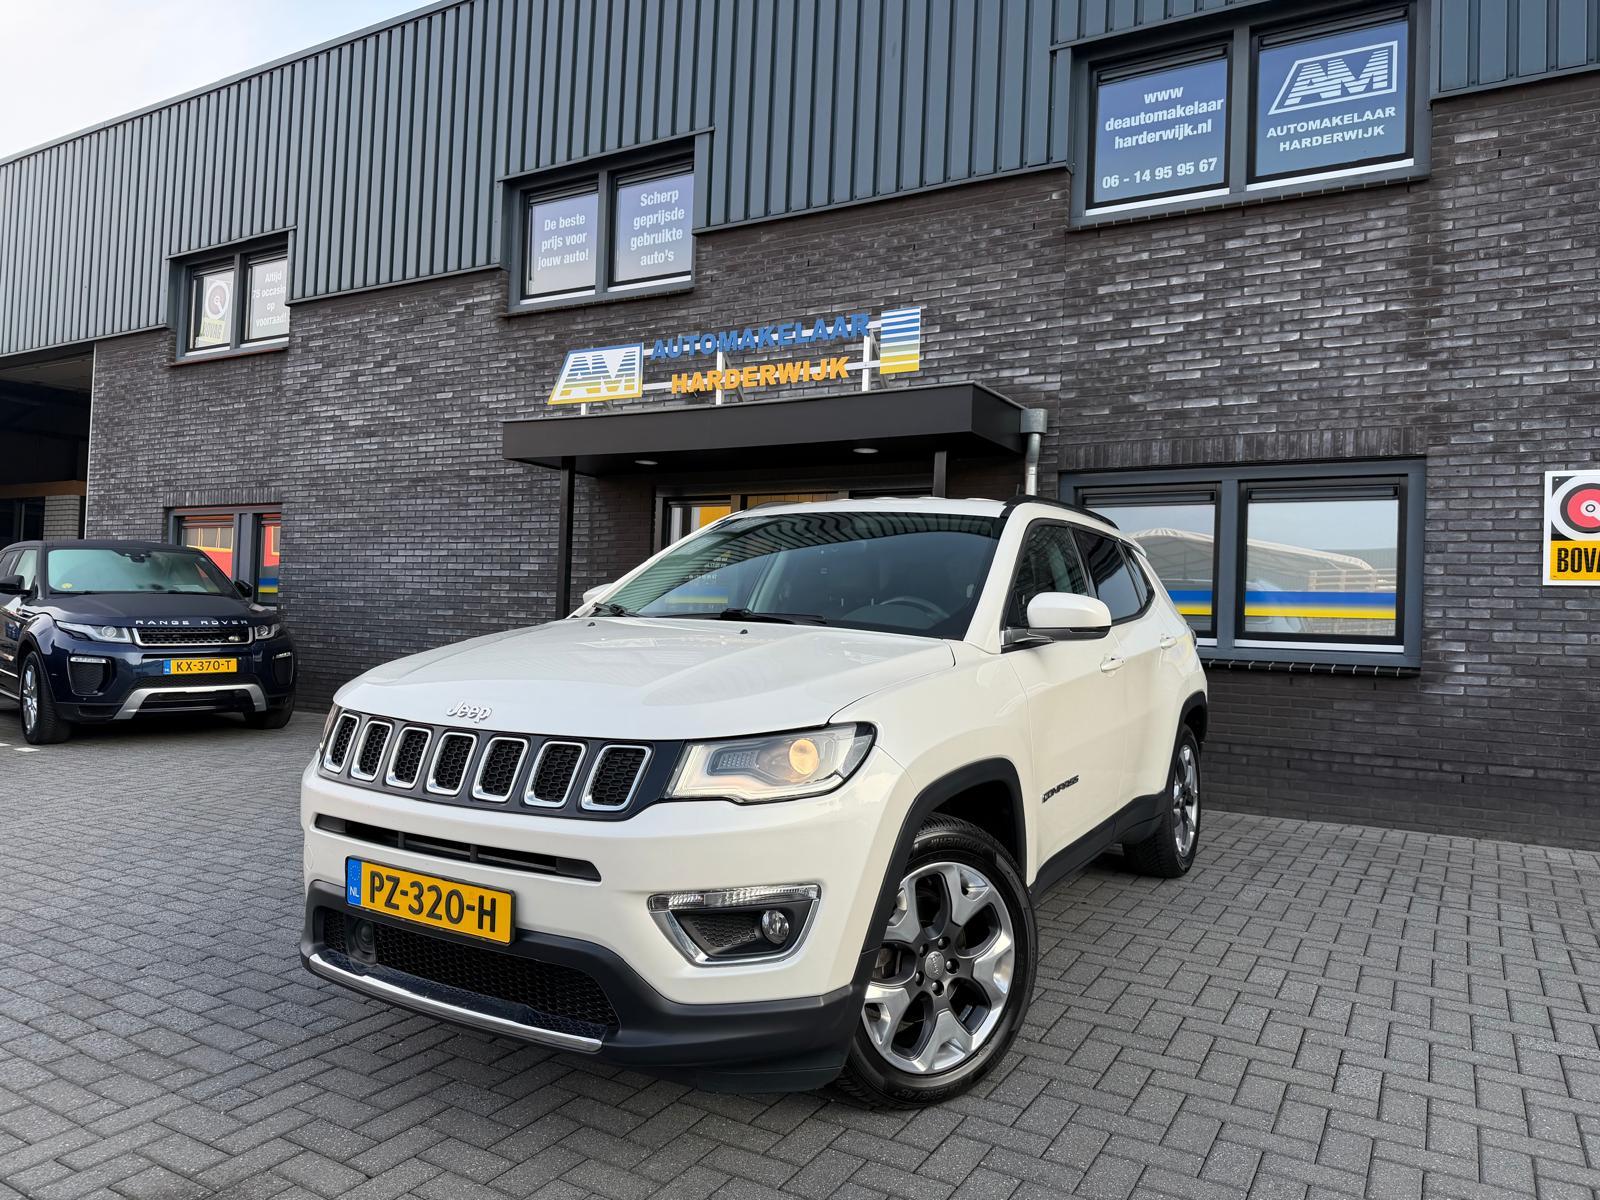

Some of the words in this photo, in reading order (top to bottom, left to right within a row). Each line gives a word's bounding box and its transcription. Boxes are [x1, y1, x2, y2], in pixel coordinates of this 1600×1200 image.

[1143, 85, 1183, 104] www
[1105, 98, 1224, 132] deautomakelaar
[1266, 106, 1397, 138] AUTOMAKELAAR
[1114, 119, 1212, 150] harderwijk.nl
[1279, 124, 1385, 152] HARDERWIJK
[1102, 173, 1119, 189] 06
[1134, 168, 1151, 184] 14
[1154, 165, 1173, 181] 95
[1176, 161, 1195, 177] 95
[1198, 157, 1218, 173] 67
[640, 189, 679, 207] Scherp
[544, 219, 557, 231] De
[559, 213, 586, 229] beste
[633, 207, 685, 230] geprijsde
[541, 235, 563, 252] prijs
[566, 231, 587, 247] voor
[630, 228, 683, 251] gebruikte
[537, 254, 561, 271] jouw
[564, 248, 589, 263] auto!
[640, 250, 675, 266] auto's
[266, 302, 275, 311] op
[650, 312, 870, 361] AUTOMAKELAAR
[670, 356, 851, 395] HARDERWIJK
[1557, 547, 1600, 573] BOV
[176, 660, 231, 672] KX-370-T
[447, 701, 493, 723] Jeep
[350, 886, 360, 898] NL
[369, 870, 497, 933] PZ-320-H
